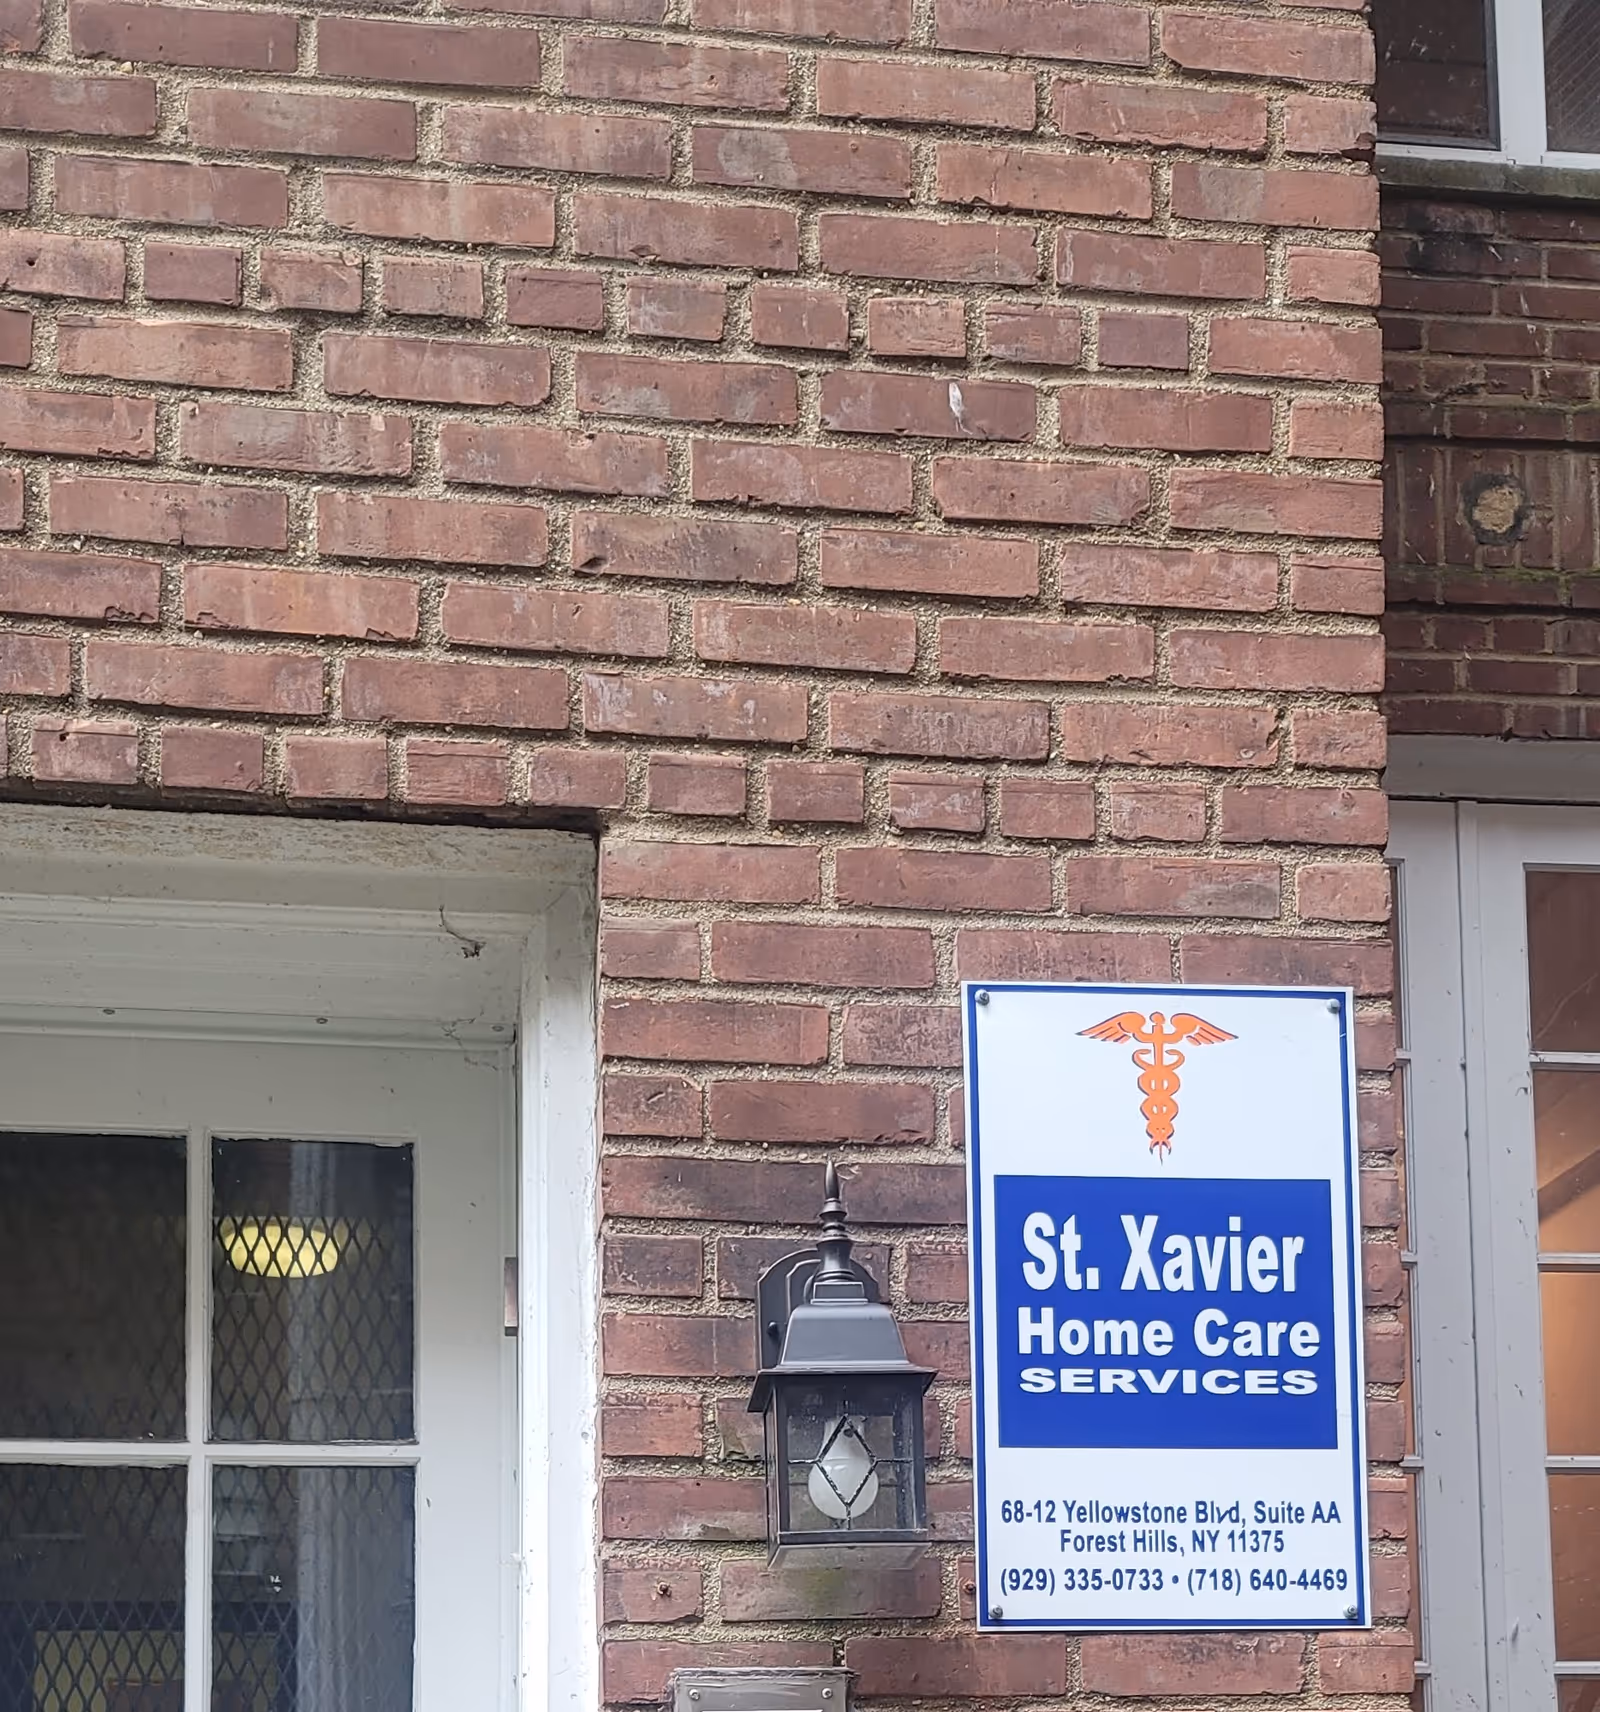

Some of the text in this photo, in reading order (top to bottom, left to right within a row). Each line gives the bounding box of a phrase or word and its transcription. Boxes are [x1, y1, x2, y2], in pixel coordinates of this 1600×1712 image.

[1022, 1212, 1304, 1293] St. Xavier
[1018, 1306, 1320, 1357] Home Care
[1019, 1367, 1318, 1395] SERVICES
[1001, 1499, 1342, 1529] 68-12 Yellowstone Blvd, Suite AA
[1060, 1529, 1285, 1557] Forest Hills, NY 11375
[1000, 1567, 1348, 1597] (929) 335-0733 (718) 640-4469
